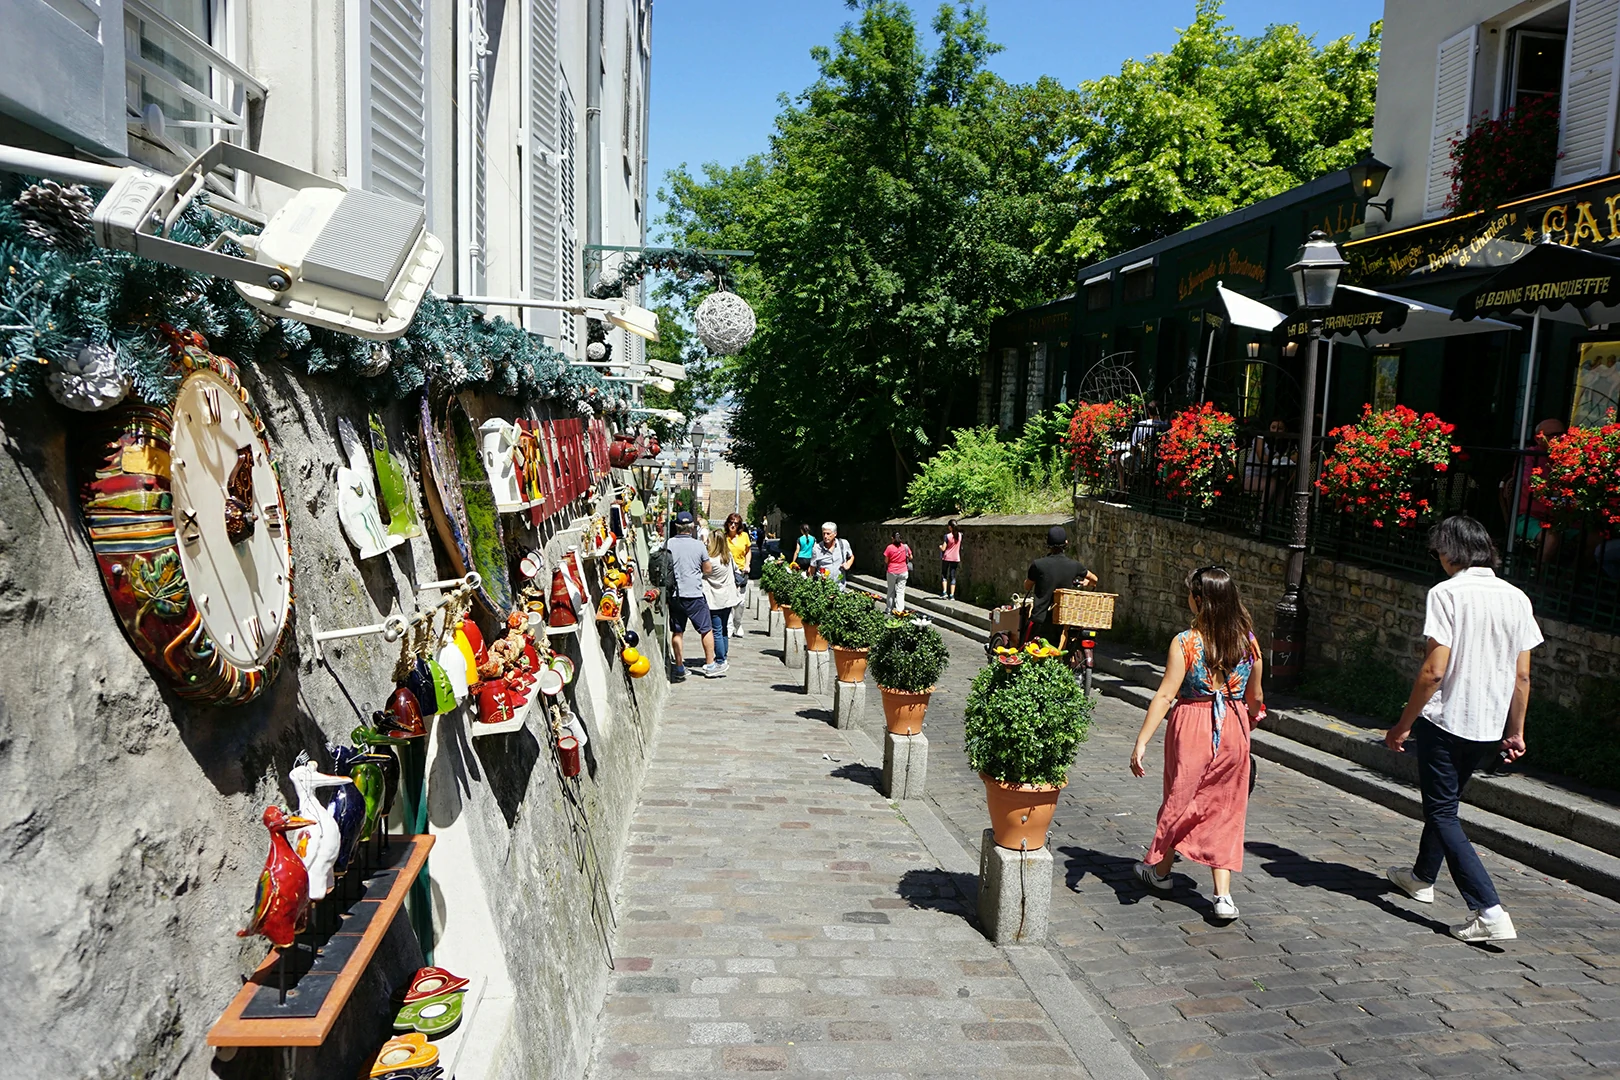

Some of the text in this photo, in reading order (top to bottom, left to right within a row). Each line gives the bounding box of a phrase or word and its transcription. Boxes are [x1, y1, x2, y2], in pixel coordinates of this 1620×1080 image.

[1458, 249, 1472, 267] et
[1469, 212, 1509, 254] Chanter
[1426, 243, 1461, 273] Boire
[1485, 286, 1524, 307] BONNE
[1523, 276, 1612, 301] FRANQUETTE
[1287, 323, 1297, 338] LA
[1325, 311, 1384, 329] FRANQUETTE
